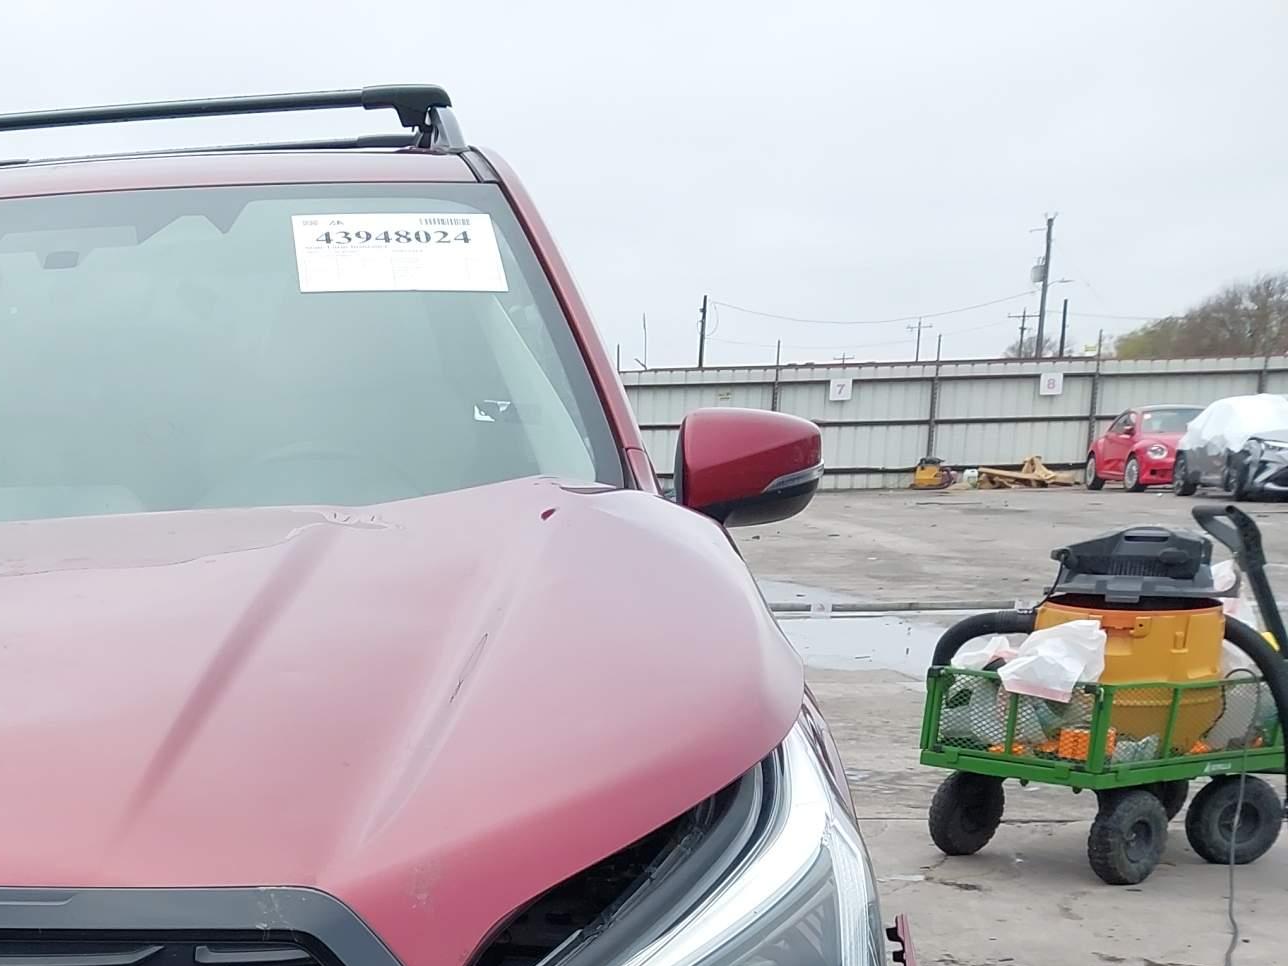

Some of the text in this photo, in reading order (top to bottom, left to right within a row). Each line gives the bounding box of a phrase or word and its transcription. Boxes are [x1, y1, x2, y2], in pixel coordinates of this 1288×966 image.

[315, 230, 472, 245] 43948024
[836, 384, 846, 395] 7
[1046, 378, 1056, 390] 8
